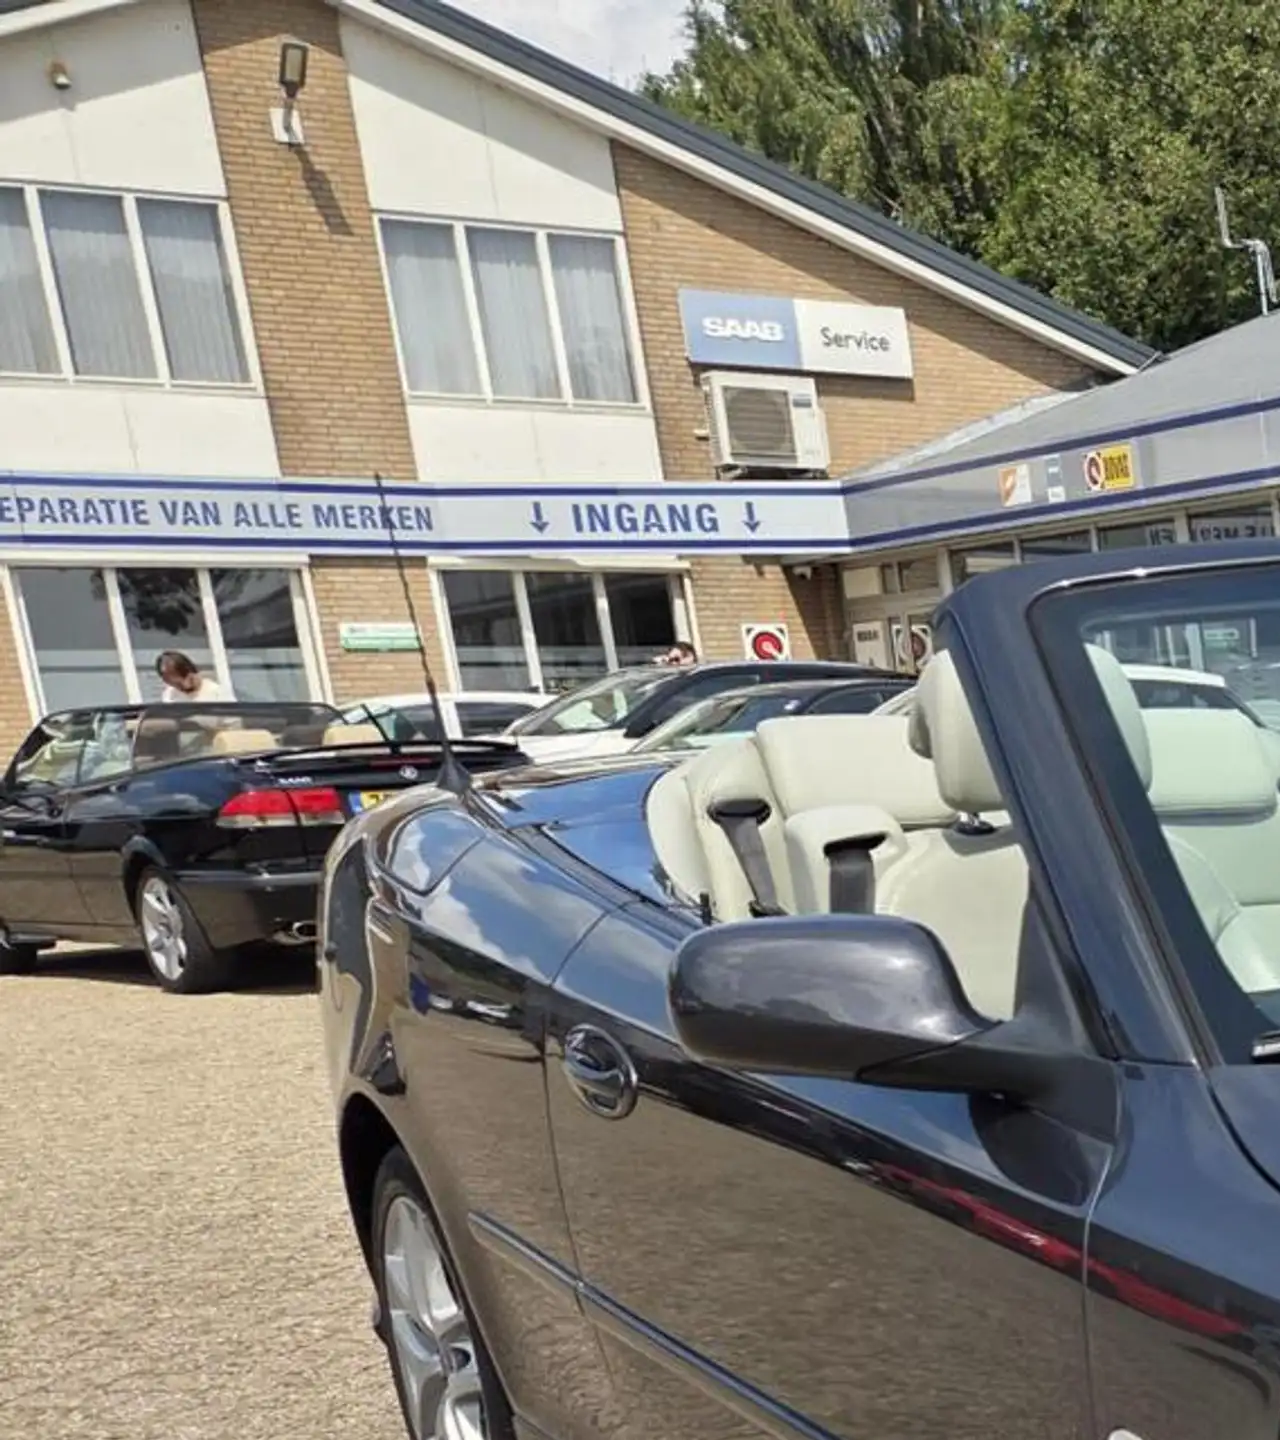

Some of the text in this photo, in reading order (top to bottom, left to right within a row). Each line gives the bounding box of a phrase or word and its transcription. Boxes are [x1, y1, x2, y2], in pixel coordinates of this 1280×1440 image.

[701, 316, 786, 342] SAAB
[820, 326, 892, 352] Service
[159, 499, 221, 527] VAN
[233, 501, 302, 529] ALLE
[313, 503, 434, 531] MERKEN
[571, 502, 720, 534] INGANG
